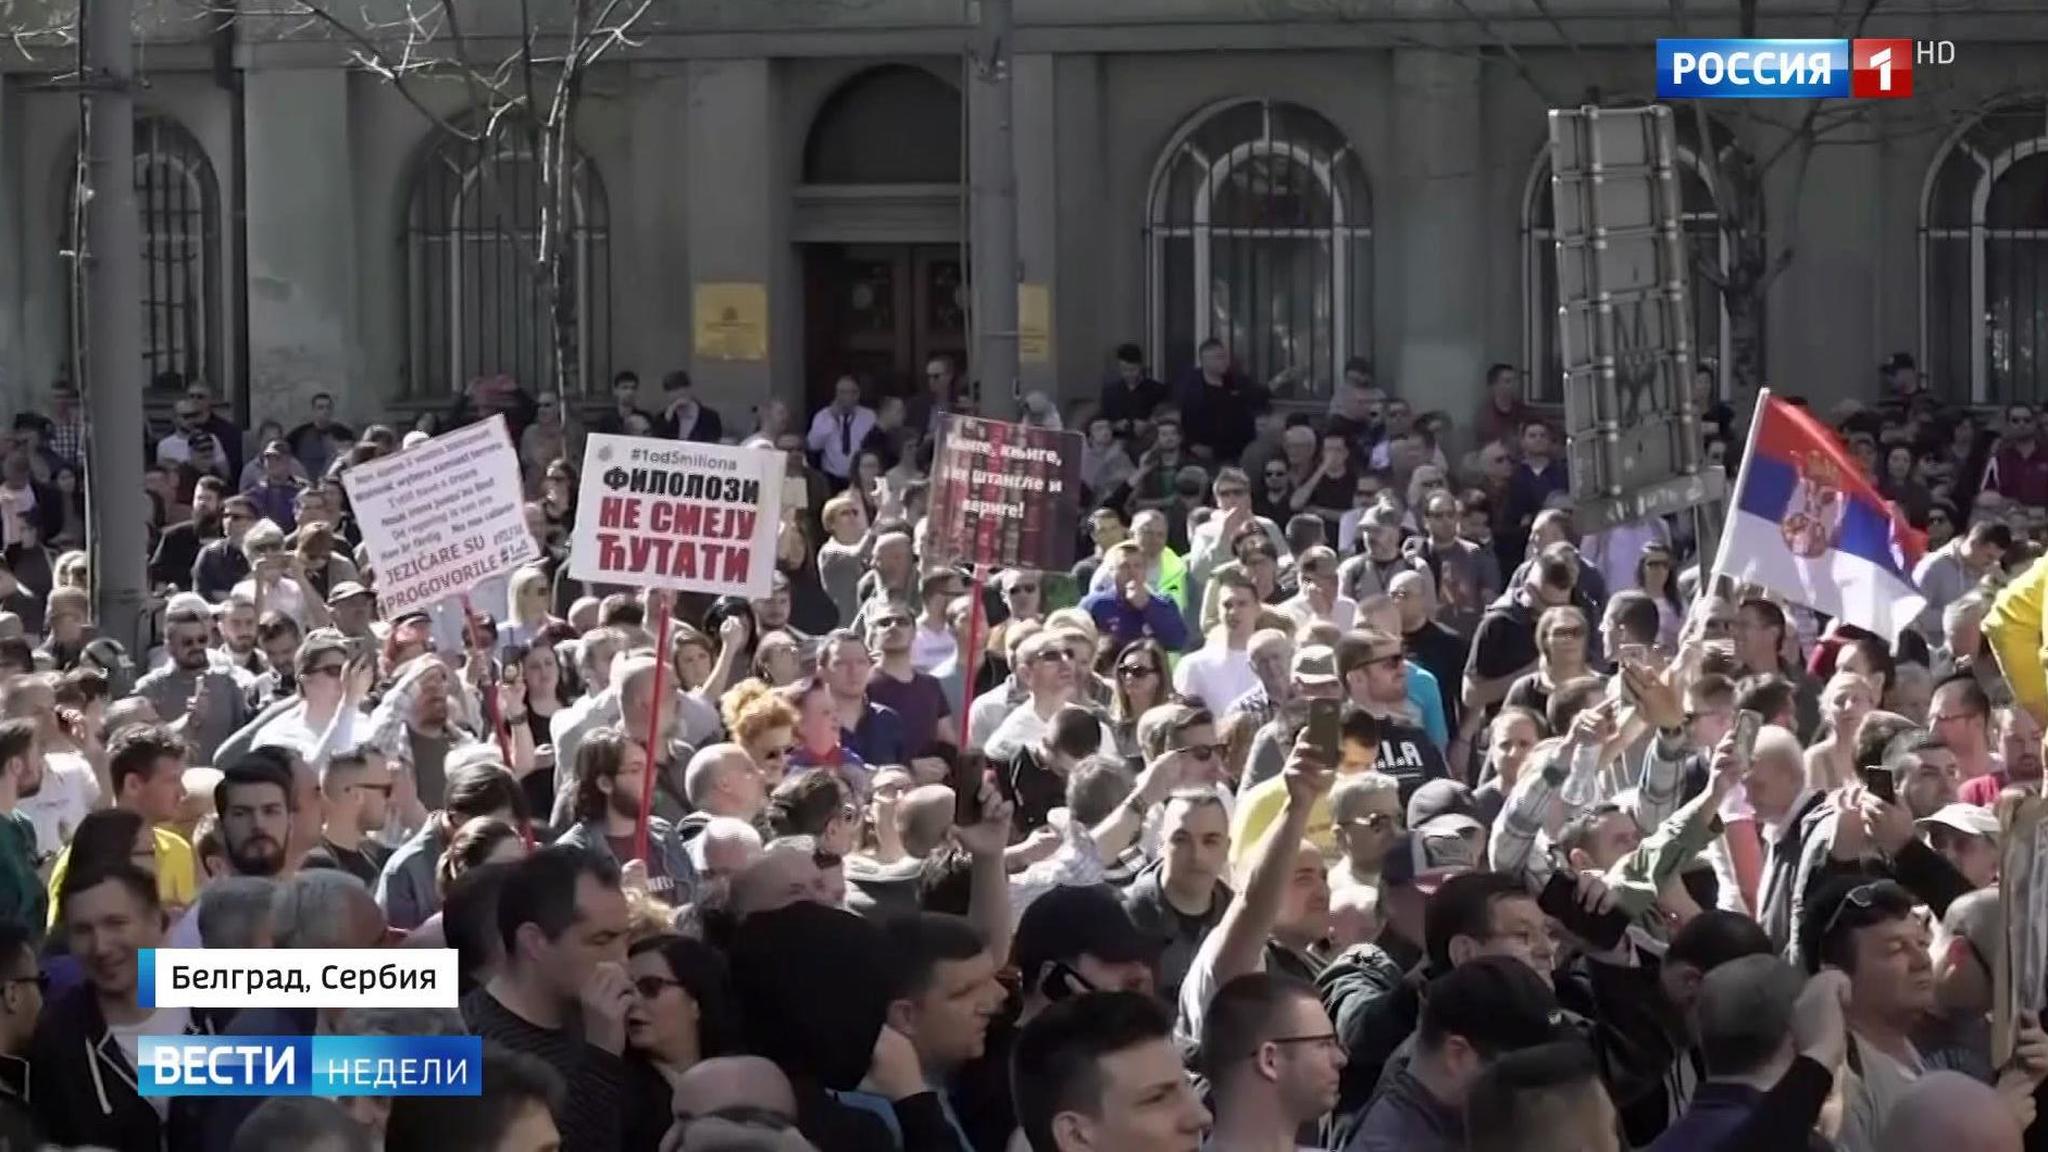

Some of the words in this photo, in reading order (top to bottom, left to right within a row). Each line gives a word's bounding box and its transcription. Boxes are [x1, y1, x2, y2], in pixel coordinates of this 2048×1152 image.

[630, 448, 738, 471] #1od5miliona
[603, 465, 760, 505] ФИЛОЛОЗИ
[1049, 479, 1063, 493] и
[599, 496, 643, 529] НЕ
[651, 502, 757, 540] СМЕЈУ
[464, 535, 486, 552] SU
[596, 534, 751, 583] ЋУТАТИ
[386, 555, 498, 610] PROGOVORILE
